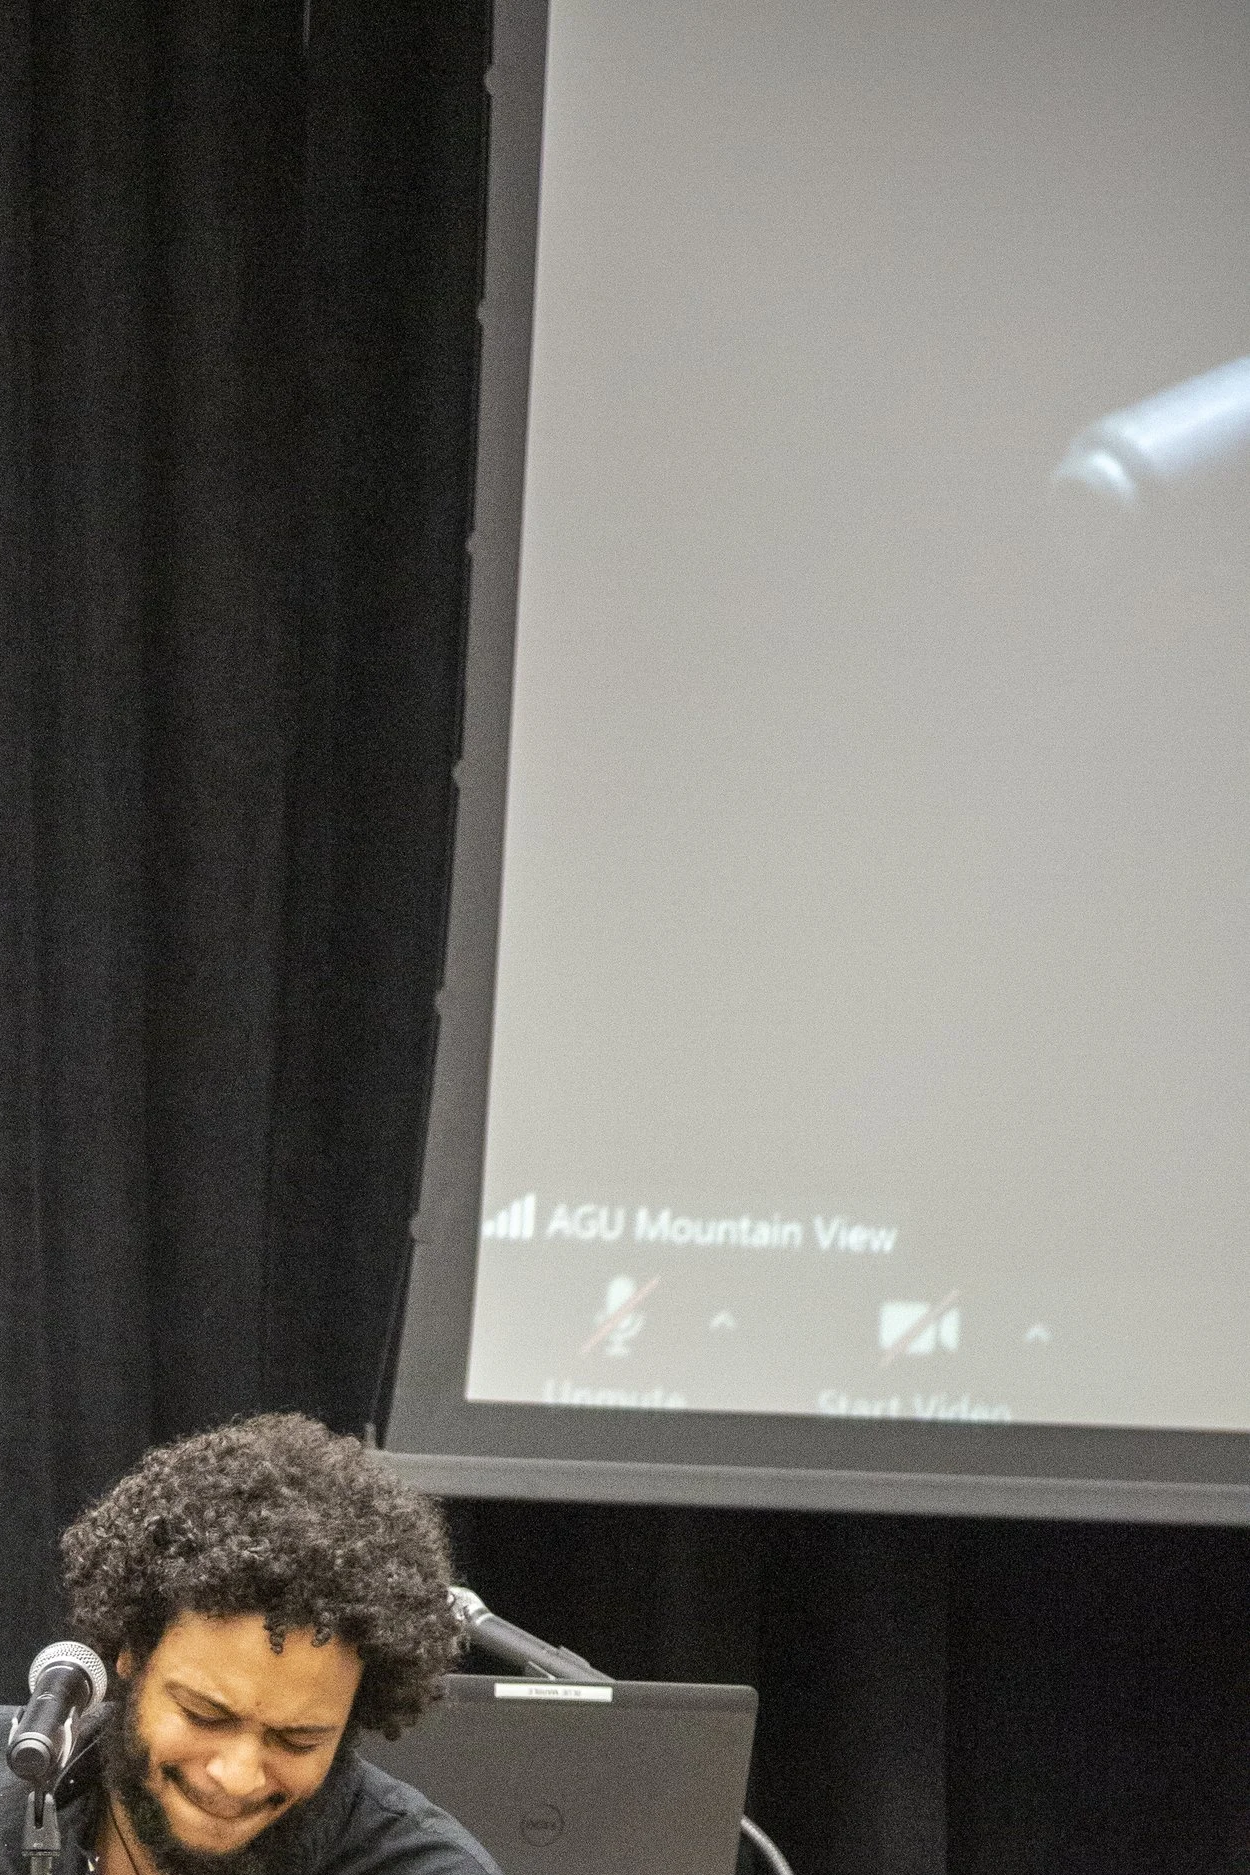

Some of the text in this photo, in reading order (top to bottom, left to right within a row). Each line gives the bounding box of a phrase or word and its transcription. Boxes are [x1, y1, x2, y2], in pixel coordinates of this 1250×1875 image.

[547, 1203, 899, 1253] AGU Mountain View
